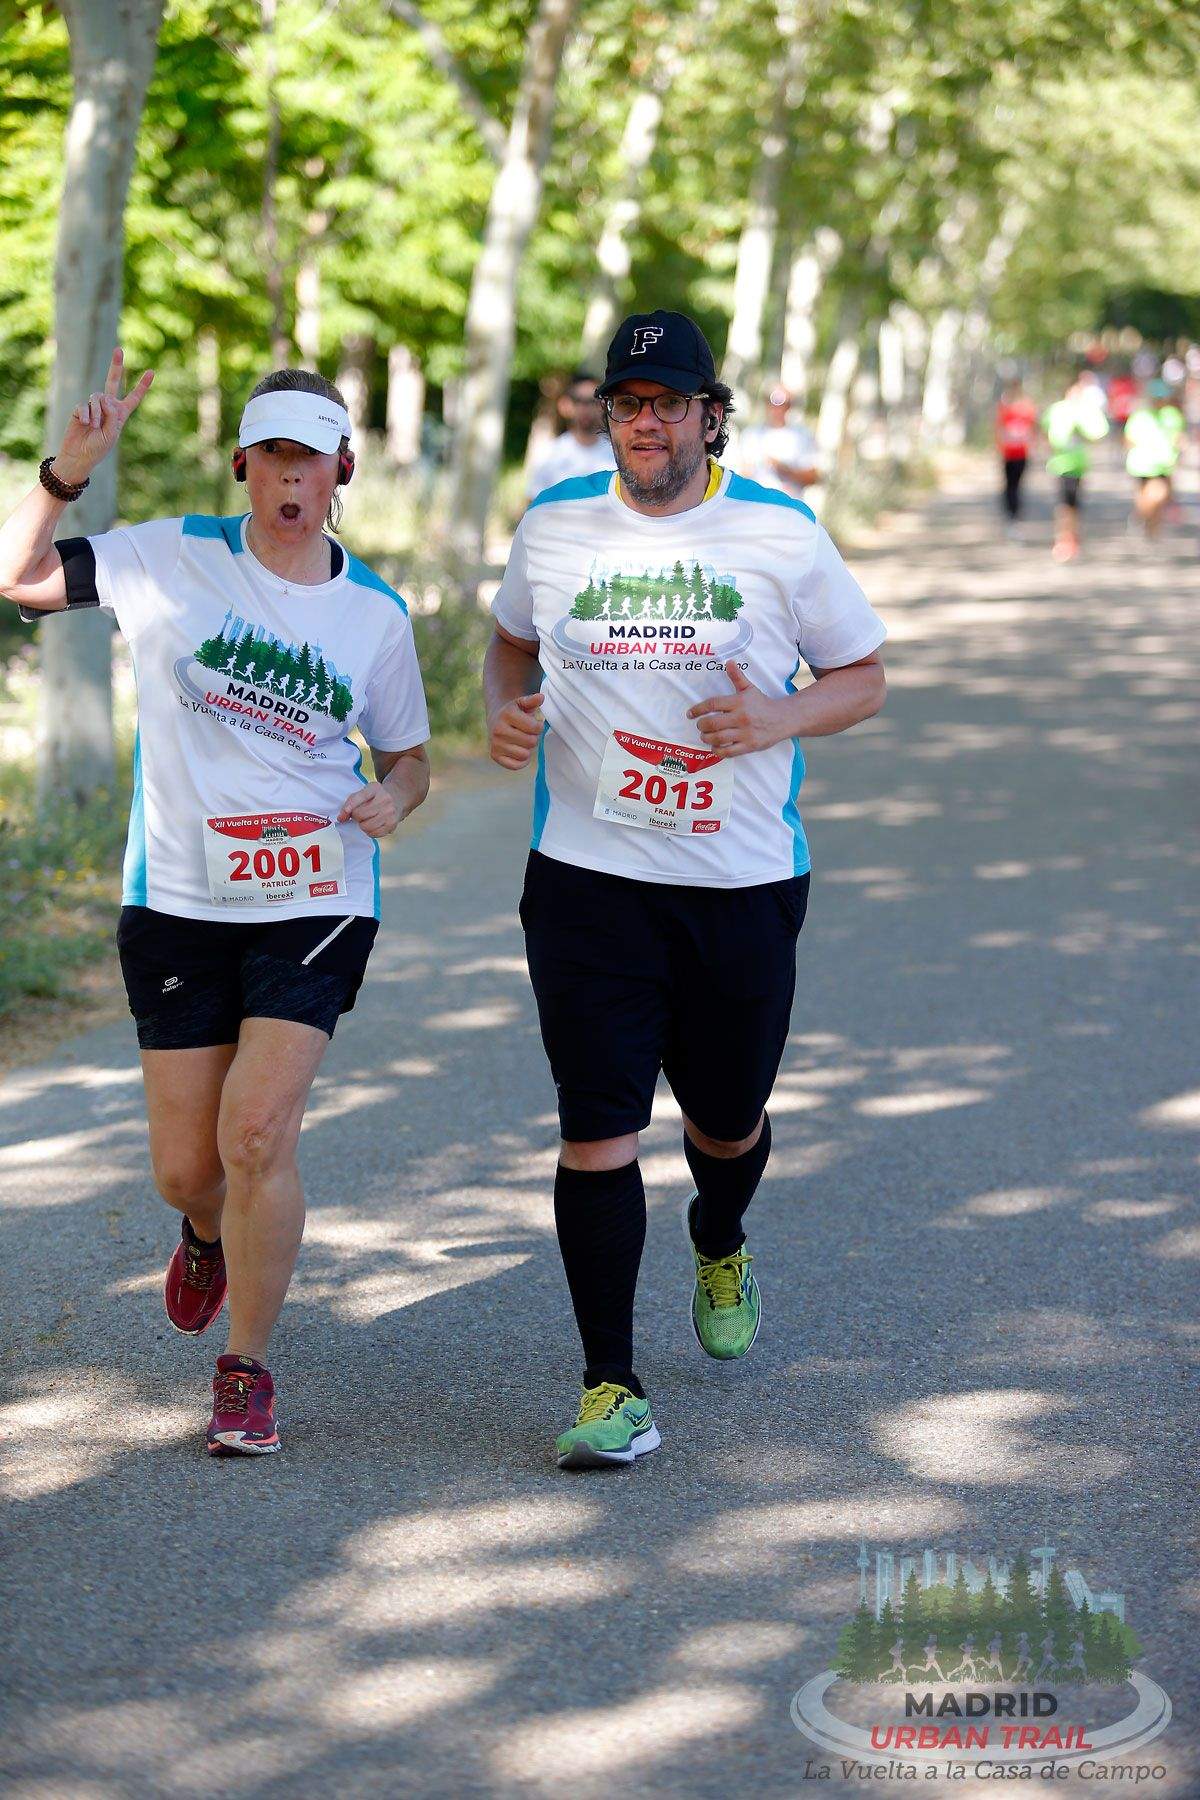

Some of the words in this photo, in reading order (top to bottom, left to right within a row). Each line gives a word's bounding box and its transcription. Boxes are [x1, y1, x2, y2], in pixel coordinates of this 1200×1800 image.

[630, 326, 664, 356] F
[608, 625, 696, 639] MADRID
[590, 642, 657, 656] URBAN
[663, 642, 716, 656] TRAIL
[562, 659, 576, 670] La
[576, 659, 618, 671] Vuelta
[633, 659, 646, 671] la
[649, 659, 682, 671] Casa
[684, 660, 702, 671] de
[706, 660, 749, 672] Cao
[226, 682, 310, 724] MADRID
[204, 691, 270, 722] URBAN
[273, 716, 318, 747] TRAIL
[229, 716, 237, 726] a
[240, 718, 251, 731] la
[254, 724, 285, 743] Casa
[619, 734, 630, 744] XII
[631, 739, 657, 751] Vuelta
[664, 746, 672, 754] la
[674, 748, 694, 760] Casa
[695, 752, 706, 760] de
[618, 769, 714, 811] 2013
[214, 821, 226, 829] XII
[226, 819, 252, 828] Vuelta
[260, 817, 268, 825] la
[271, 816, 294, 824] Casa
[303, 815, 328, 825] Campo
[612, 809, 638, 820] MADRID
[654, 807, 676, 817] FRAN
[227, 844, 322, 881] 2001
[261, 879, 297, 889] PATRICIA
